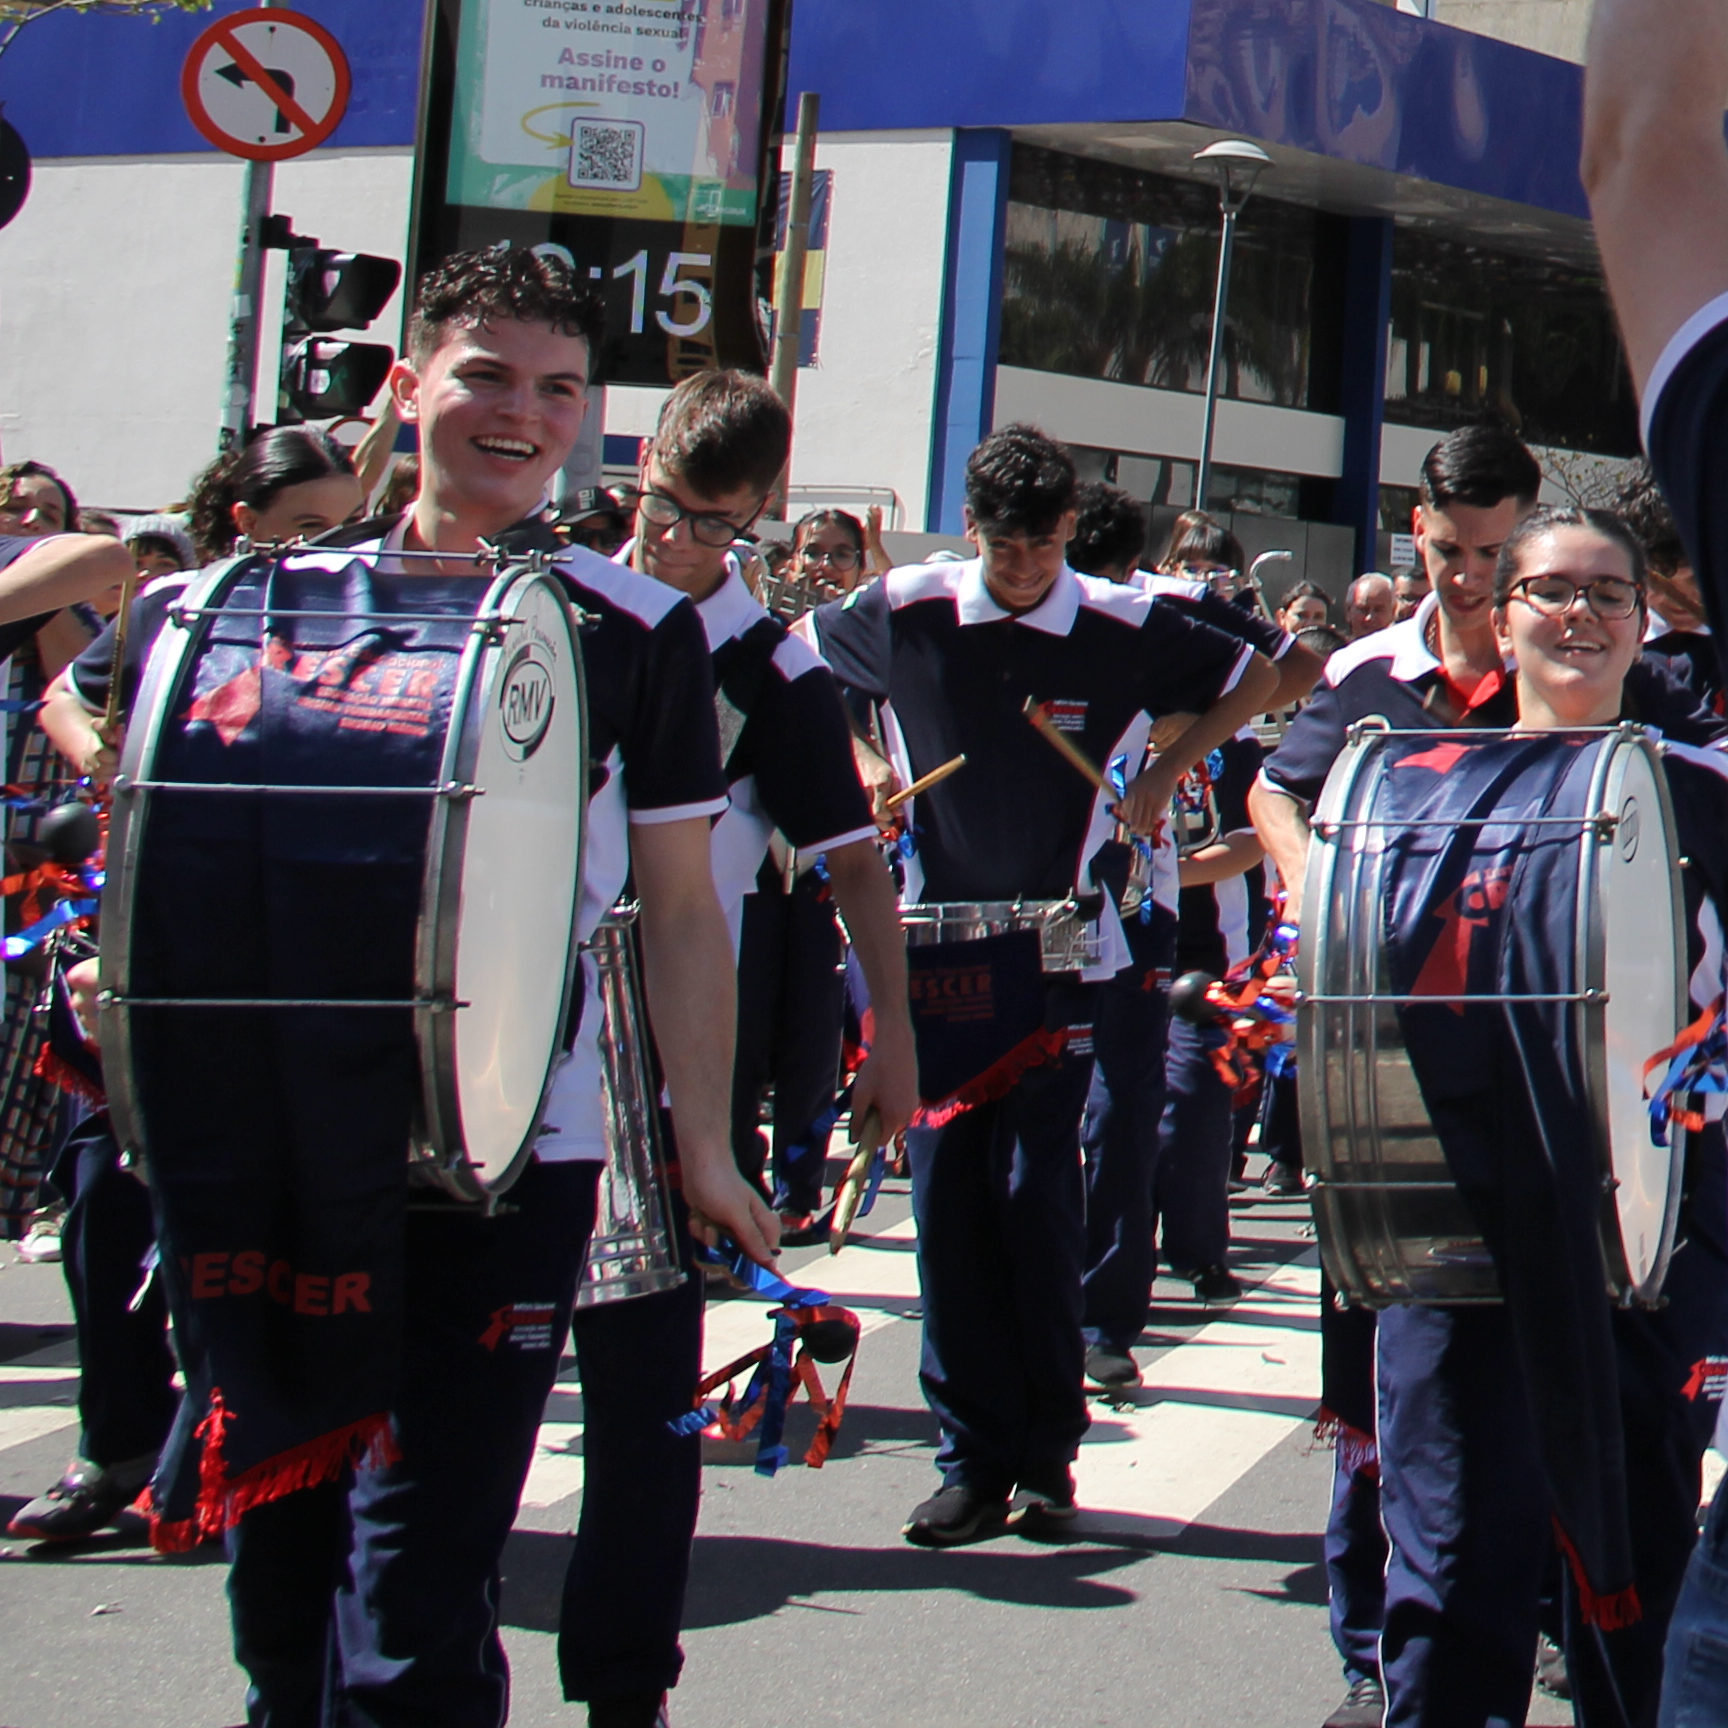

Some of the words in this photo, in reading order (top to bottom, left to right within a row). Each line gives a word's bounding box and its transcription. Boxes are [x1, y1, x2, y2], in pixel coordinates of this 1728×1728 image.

[592, 2, 602, 14] e
[605, 2, 705, 24] adolescentes
[542, 16, 562, 30] da
[564, 18, 633, 36] violência
[636, 25, 684, 40] sexual
[557, 46, 644, 72] Assine
[651, 56, 667, 73] o
[540, 72, 681, 100] manifesto!
[507, 679, 547, 727] RMV
